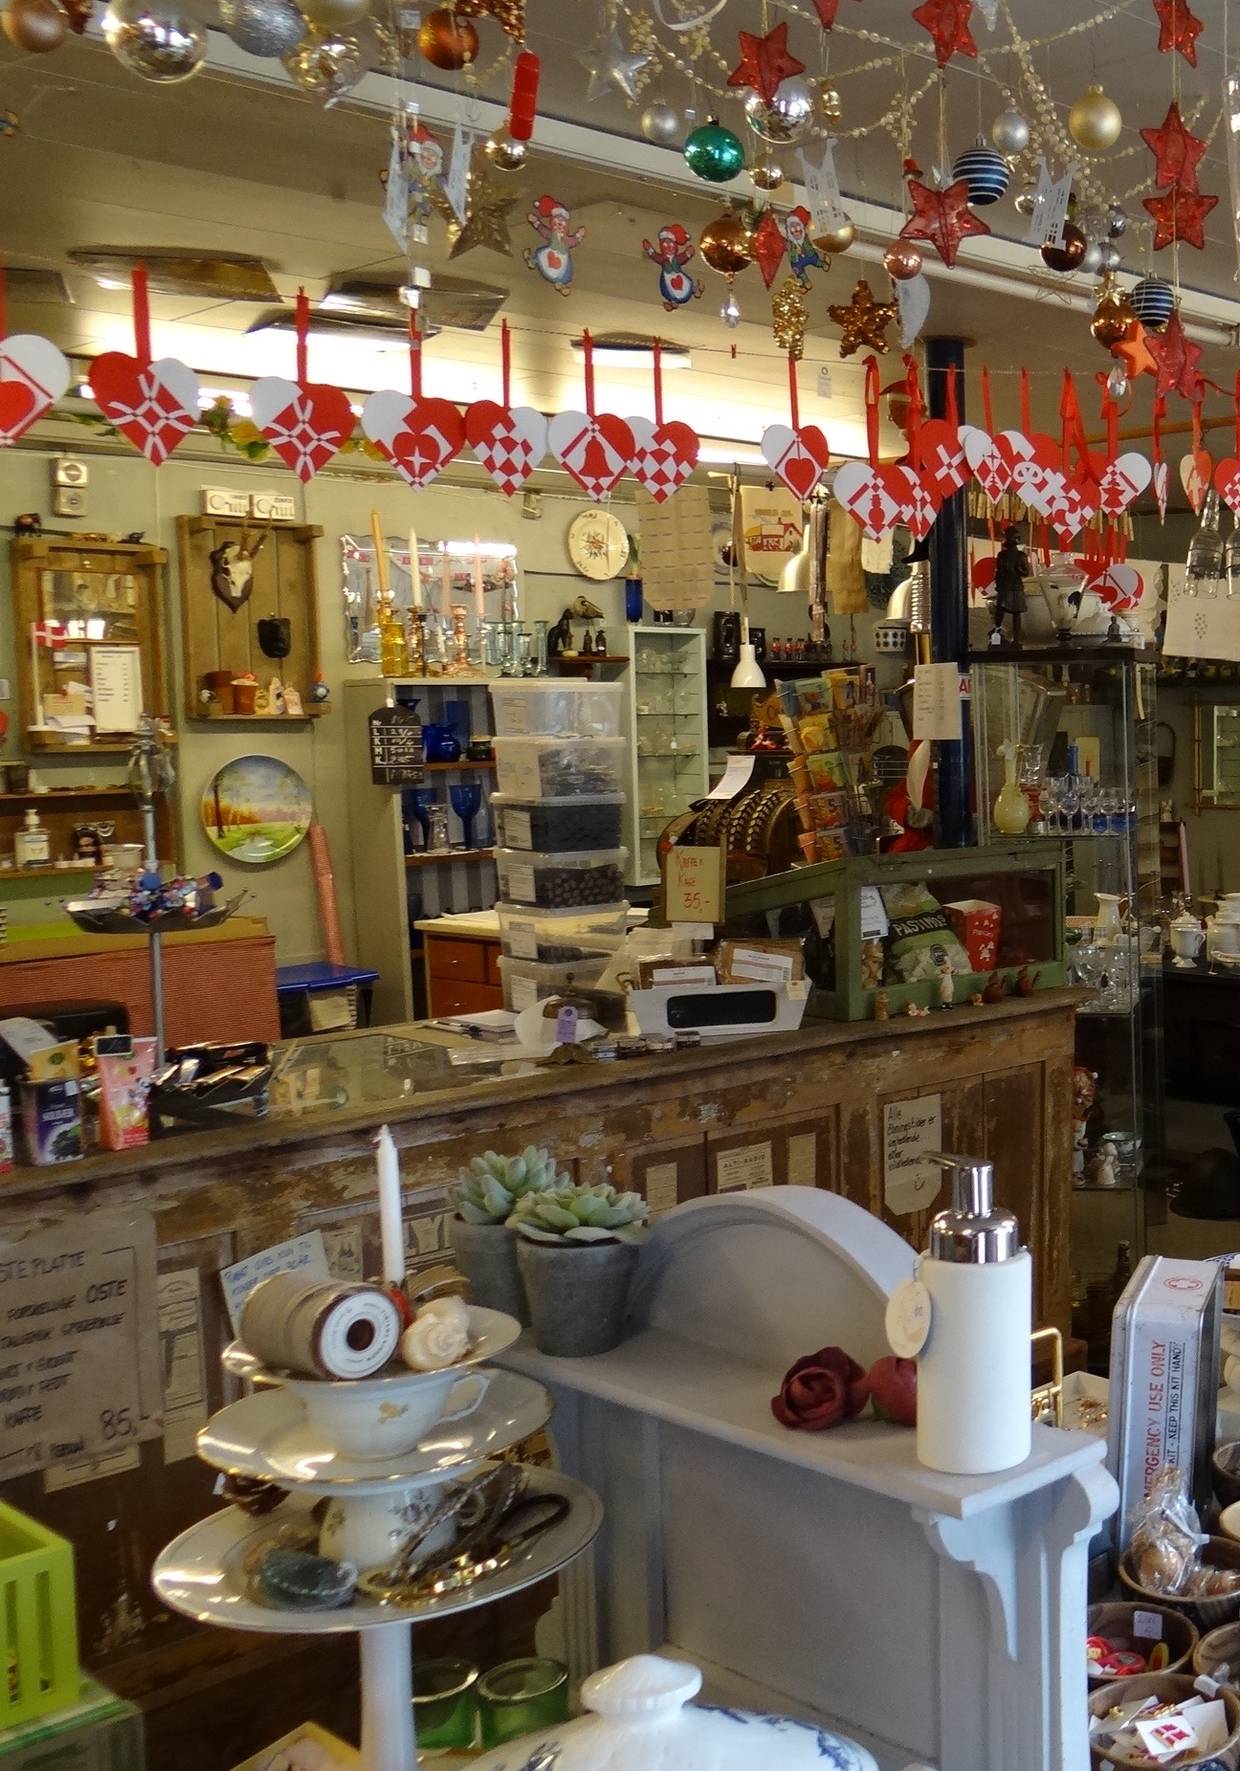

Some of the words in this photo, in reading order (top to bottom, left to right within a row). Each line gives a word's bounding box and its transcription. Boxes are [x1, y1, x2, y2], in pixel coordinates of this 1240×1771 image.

[86, 1279, 128, 1304] OSTE
[1151, 1340, 1166, 1377] ONLY
[1171, 1376, 1180, 1391] KIT
[1148, 1382, 1164, 1412] USE
[1169, 1393, 1179, 1413] THIS
[1168, 1416, 1178, 1439] KEEP
[1167, 1449, 1176, 1464] KIT
